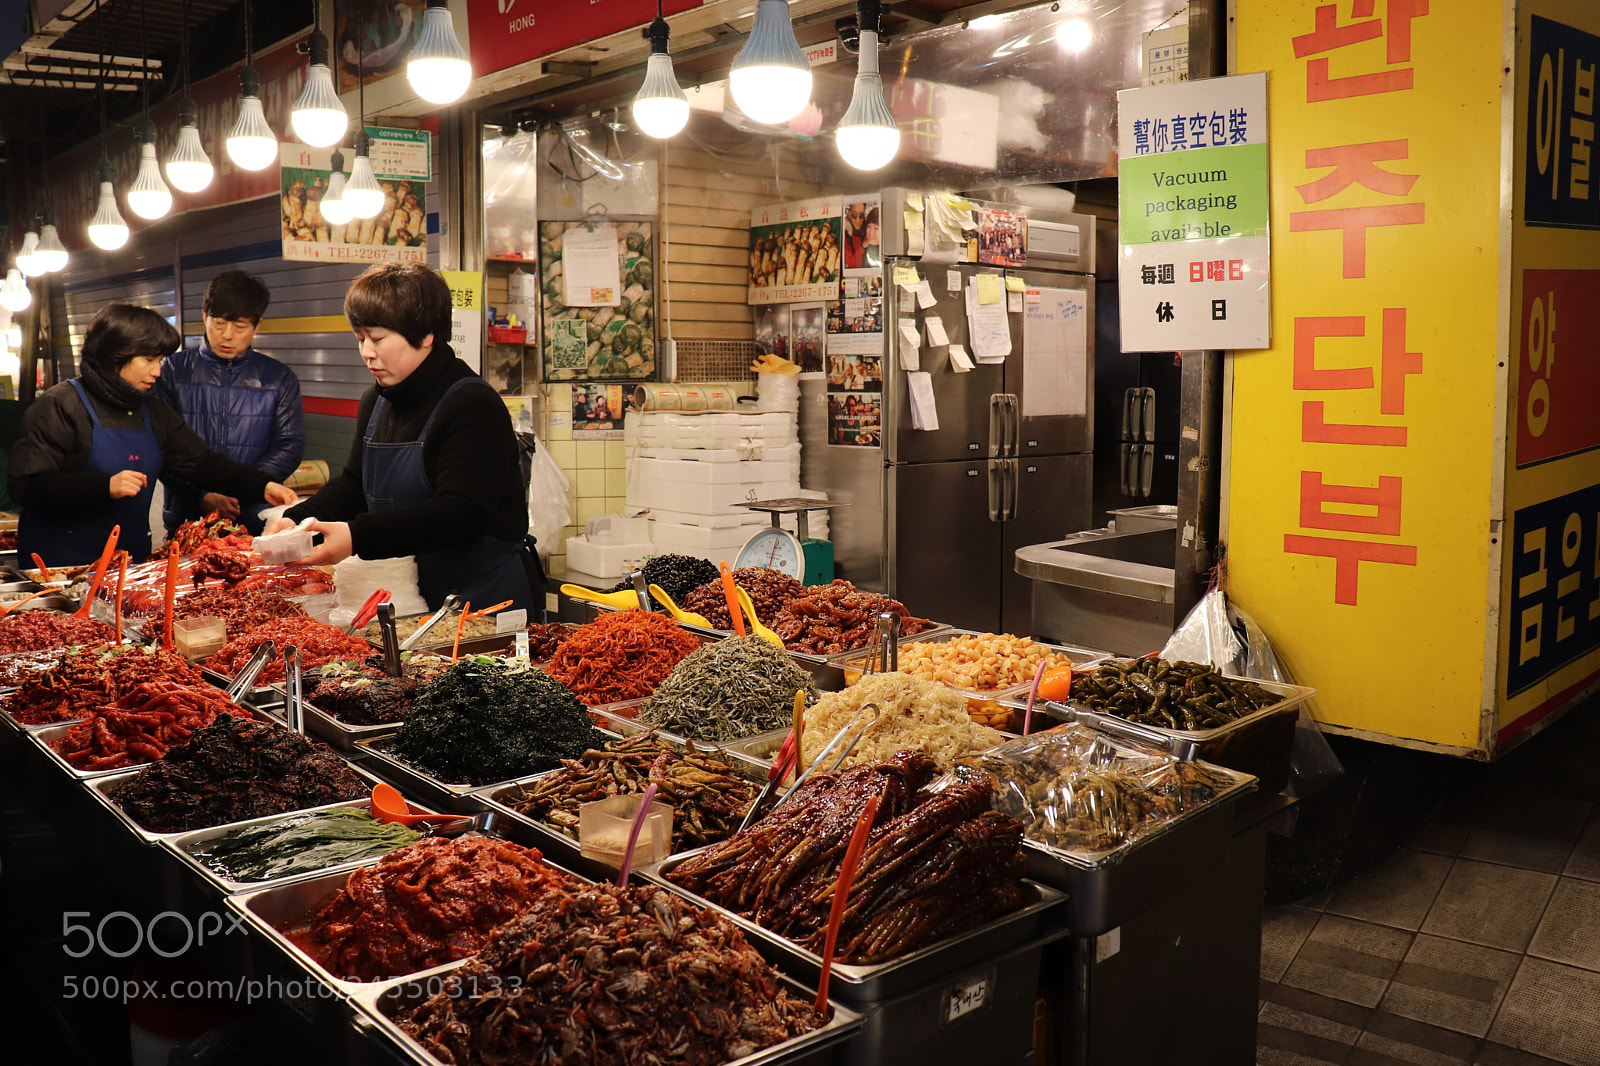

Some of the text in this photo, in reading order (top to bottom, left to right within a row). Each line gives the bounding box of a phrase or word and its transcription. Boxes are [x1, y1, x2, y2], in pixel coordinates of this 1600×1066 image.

[509, 13, 535, 34] HONG
[1133, 107, 1248, 155] 幫你真空包裝
[1536, 48, 1596, 200] 이불
[1152, 169, 1228, 187] Vacuum
[1145, 193, 1238, 217] packaging
[1151, 222, 1231, 242] available
[328, 246, 425, 262] TEL:2267-1751
[1189, 259, 1244, 283] 日曜日
[774, 286, 837, 299] TEL:2267-1751
[1526, 290, 1557, 438] 양
